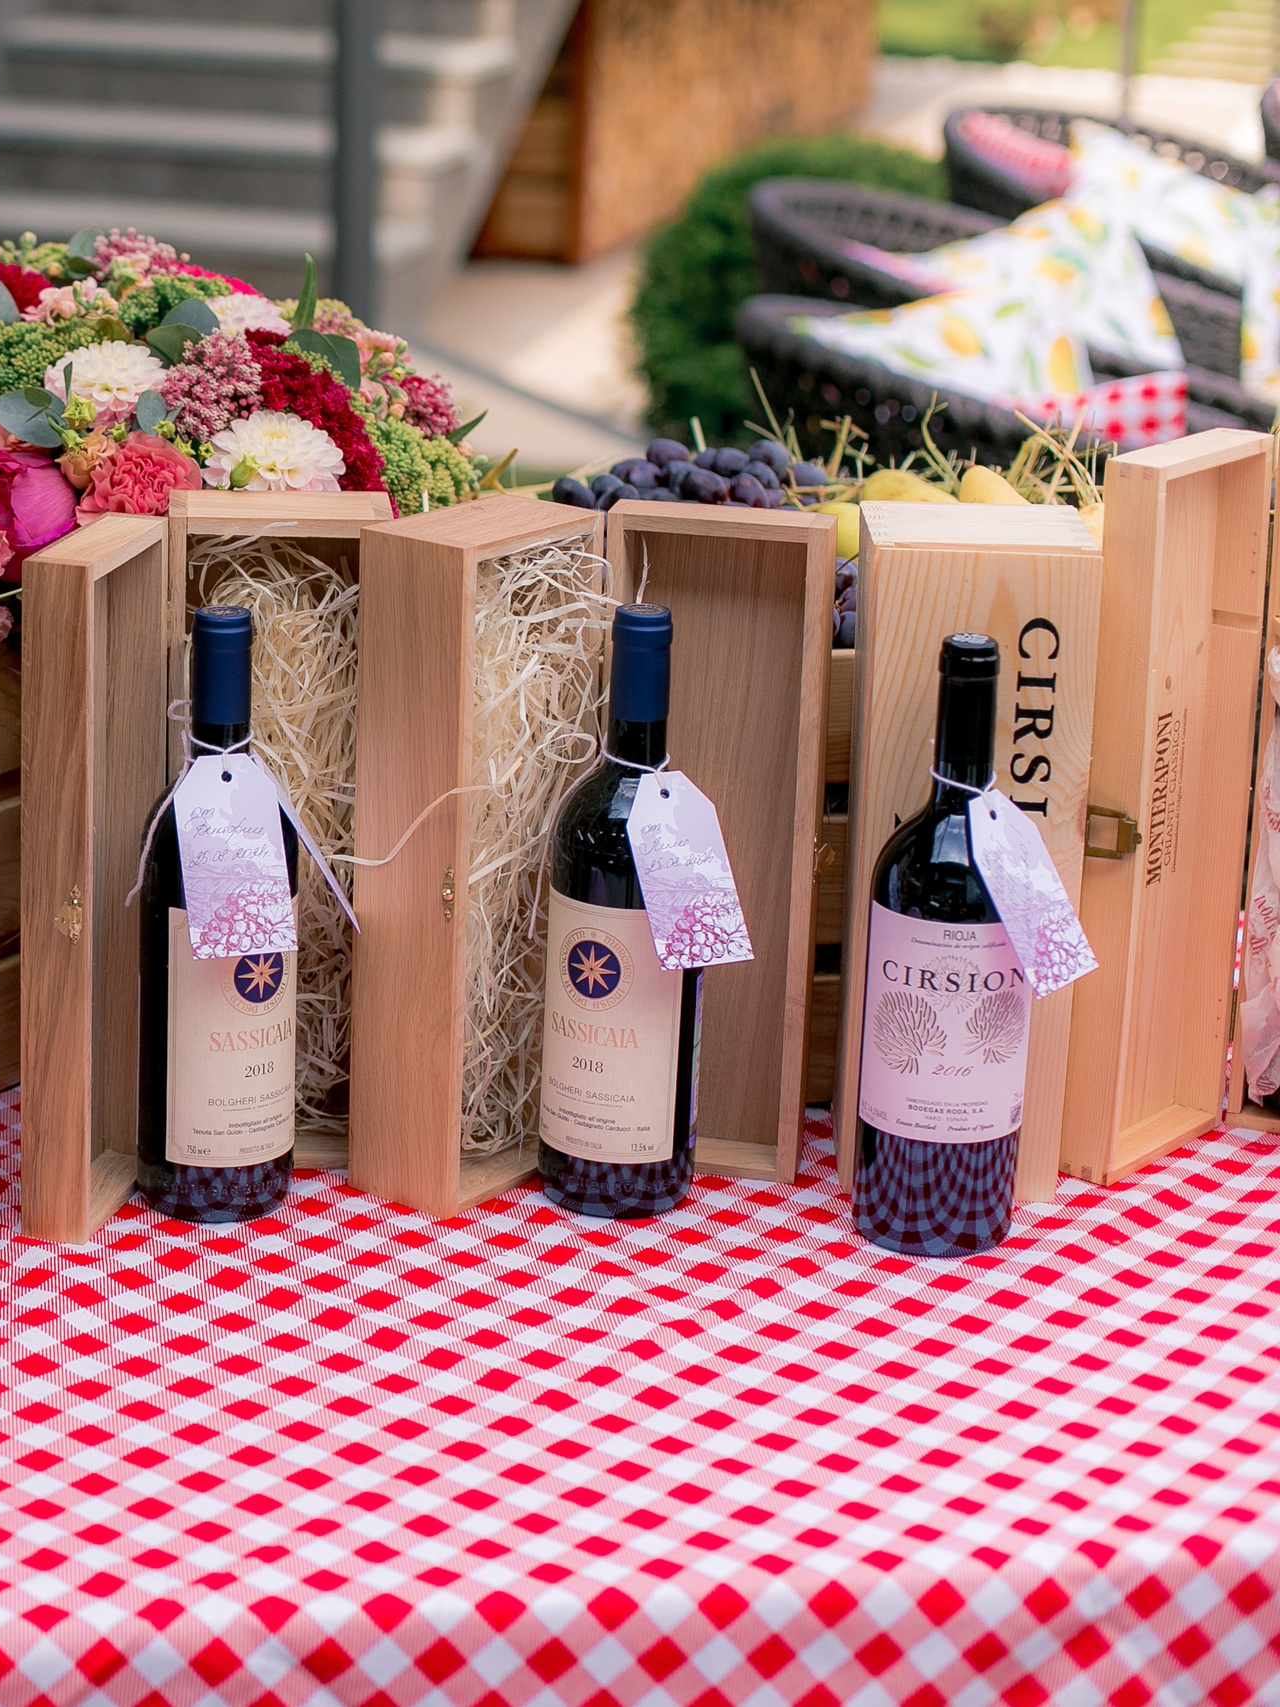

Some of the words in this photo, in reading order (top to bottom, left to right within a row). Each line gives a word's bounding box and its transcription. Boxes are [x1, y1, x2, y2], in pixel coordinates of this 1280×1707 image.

[1009, 617, 1059, 817] CIRSI
[1168, 720, 1180, 793] CLASSICO
[1145, 711, 1173, 889] MONTERAPONI
[1163, 802, 1174, 867] CHIANTI
[943, 930, 977, 941] RIOJA
[882, 959, 1024, 993] CIRSION
[209, 1018, 292, 1052] SASSICAIA
[551, 1011, 639, 1049] SASSICAIA
[245, 1061, 274, 1078] 2018
[572, 1055, 604, 1073] 2018
[931, 1063, 974, 1077] 2016
[208, 1096, 257, 1107] BOLGHERI
[260, 1082, 291, 1102] SASSICAIA
[548, 1075, 582, 1097] BOLGHERI
[585, 1091, 635, 1103] SASSICAIA
[588, 1116, 616, 1125] all'origine
[908, 1104, 944, 1114] BODEGAS
[574, 1119, 604, 1130] Castagneto
[605, 1124, 631, 1132] Carducci
[187, 1145, 197, 1155] 750
